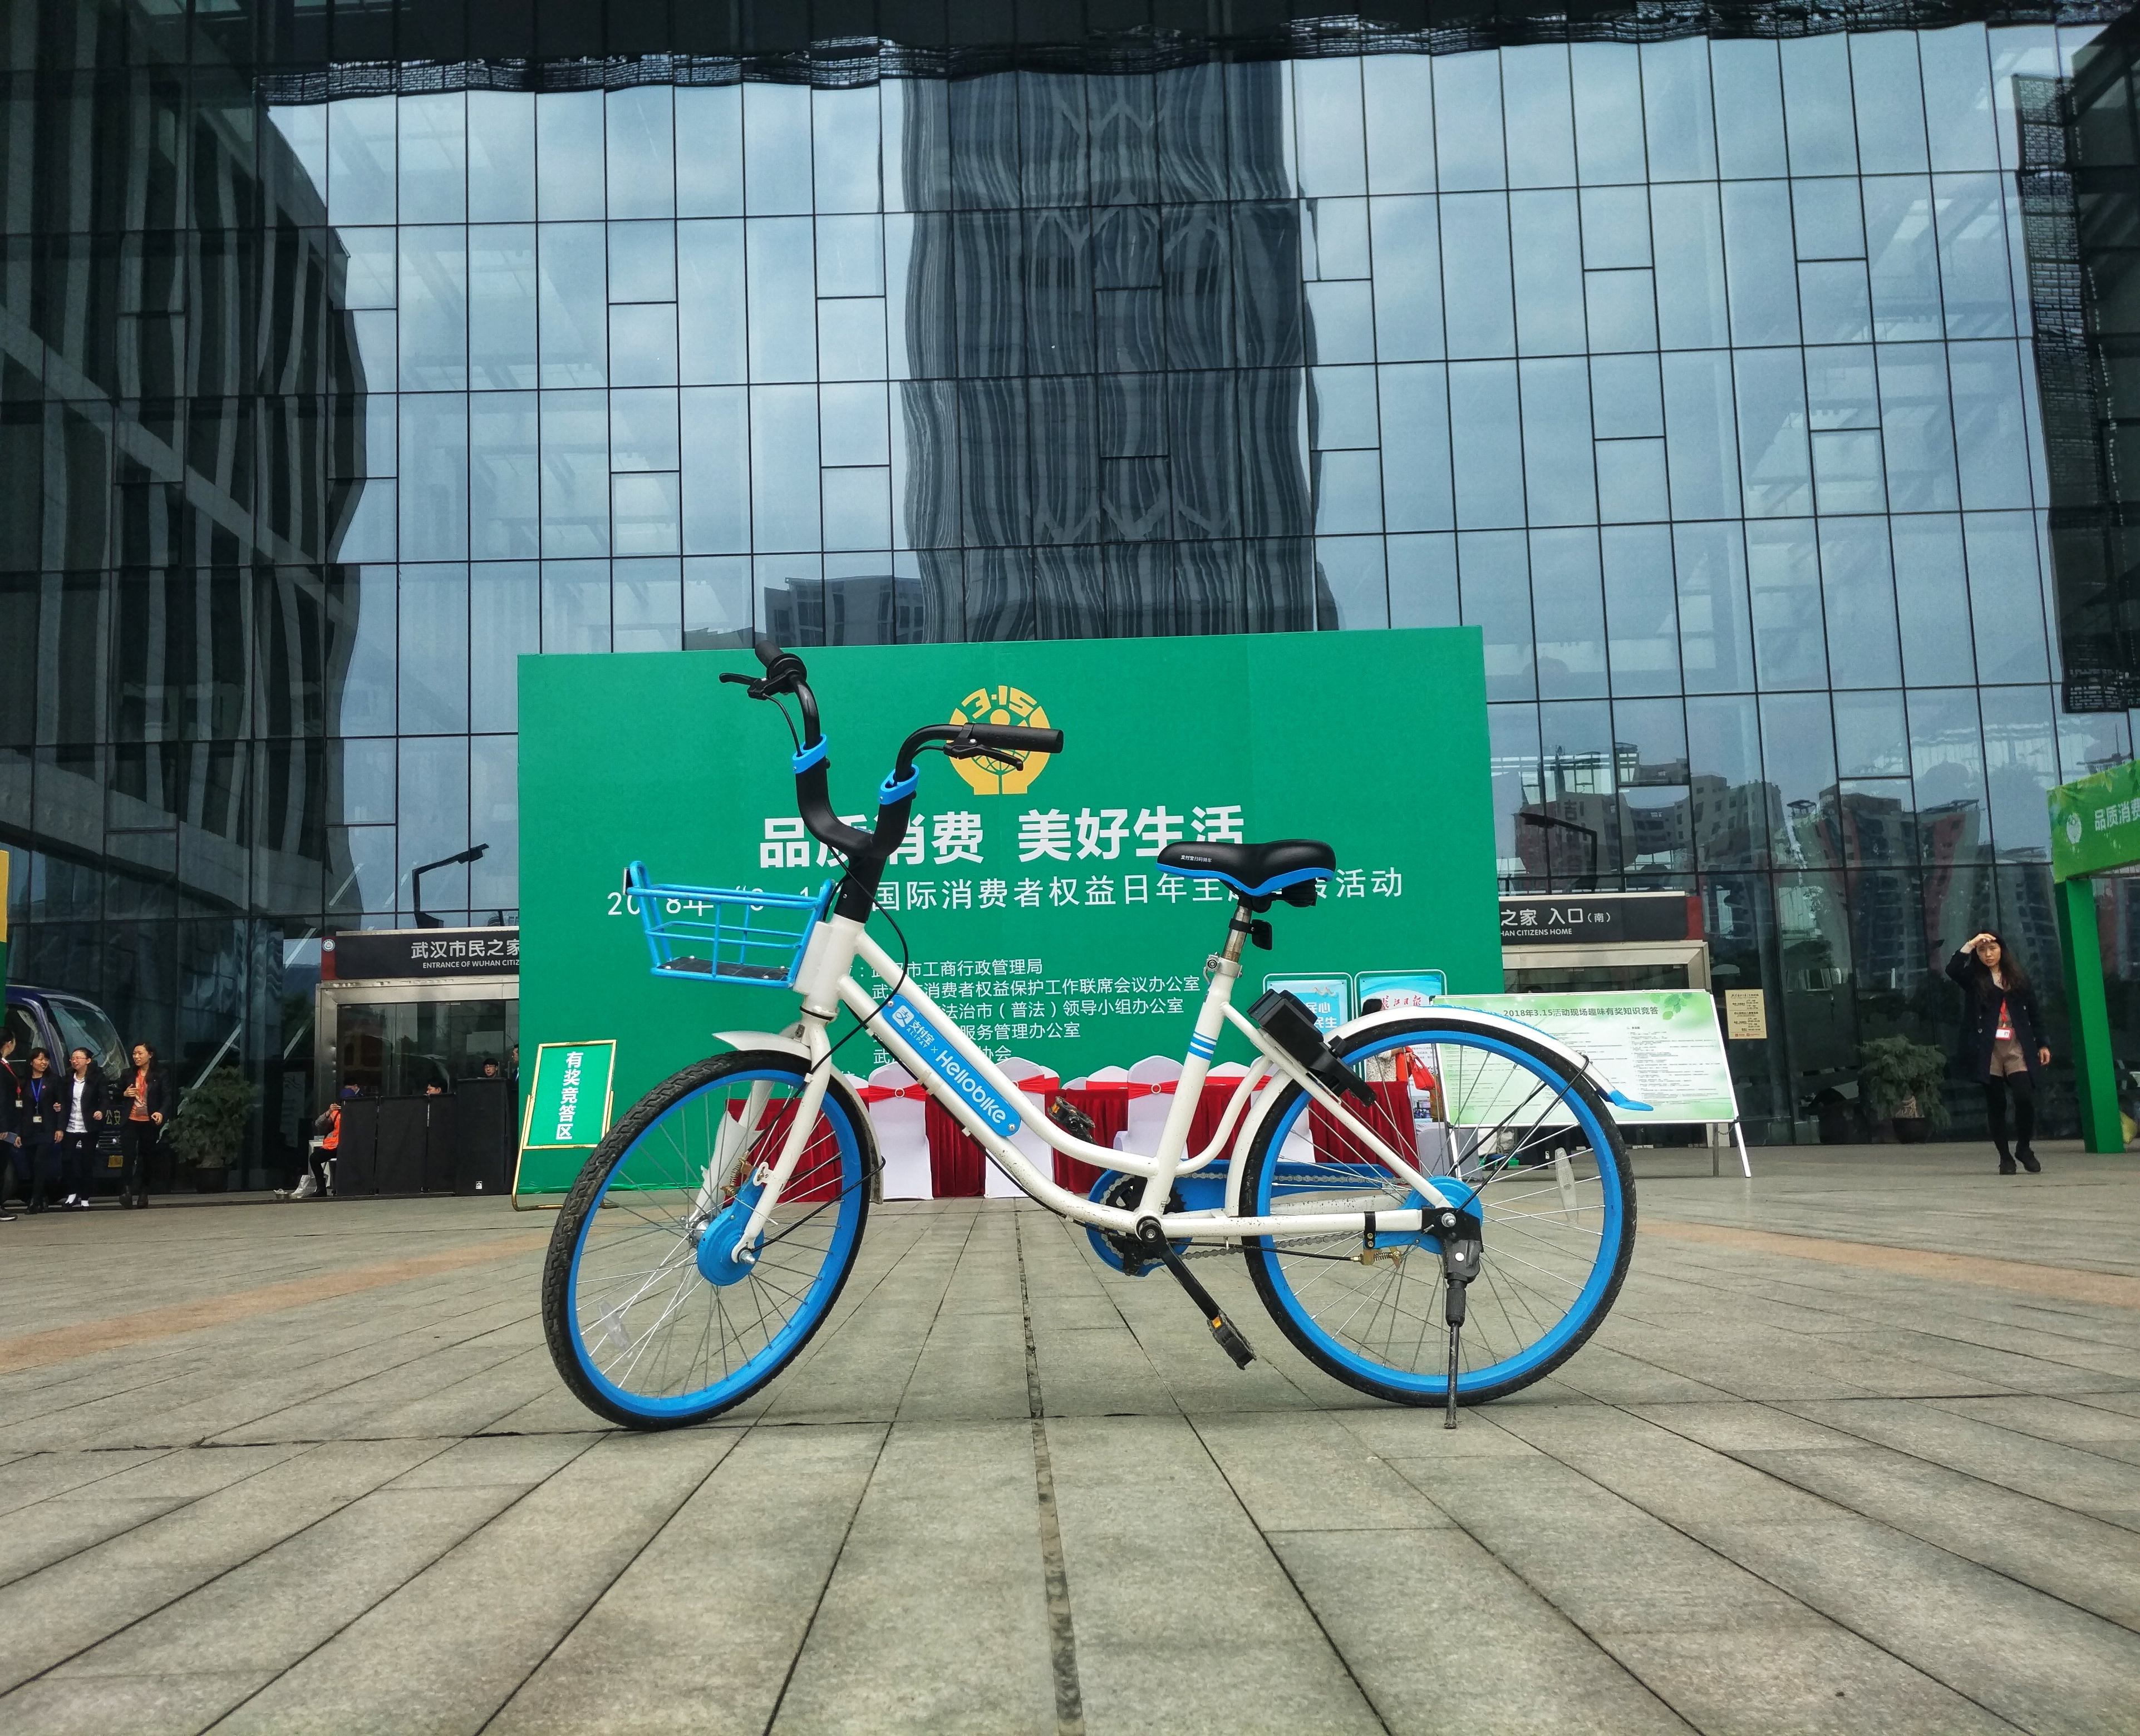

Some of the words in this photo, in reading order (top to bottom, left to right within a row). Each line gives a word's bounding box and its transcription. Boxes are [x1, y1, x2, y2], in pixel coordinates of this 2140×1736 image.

[1017, 805, 1244, 862] 美好生活
[1500, 909, 1538, 926] 之家
[411, 938, 520, 959] 武汉市民之家
[422, 961, 460, 969] ENTRANCE
[872, 975, 1201, 1000] 武消费者权益保护工作联席会议办公室
[938, 997, 1184, 1020] 法治市（普法）领导小组办公室
[1503, 1006, 1659, 1017] 2018年3.15活动现场趣味有奖知识竞答
[906, 1027, 928, 1048] ALIPAY
[908, 1019, 935, 1045] 支付宝
[555, 1051, 584, 1140] 有奖竞答区
[935, 1049, 1006, 1123] Hellobike
[105, 1109, 121, 1125] 公安
